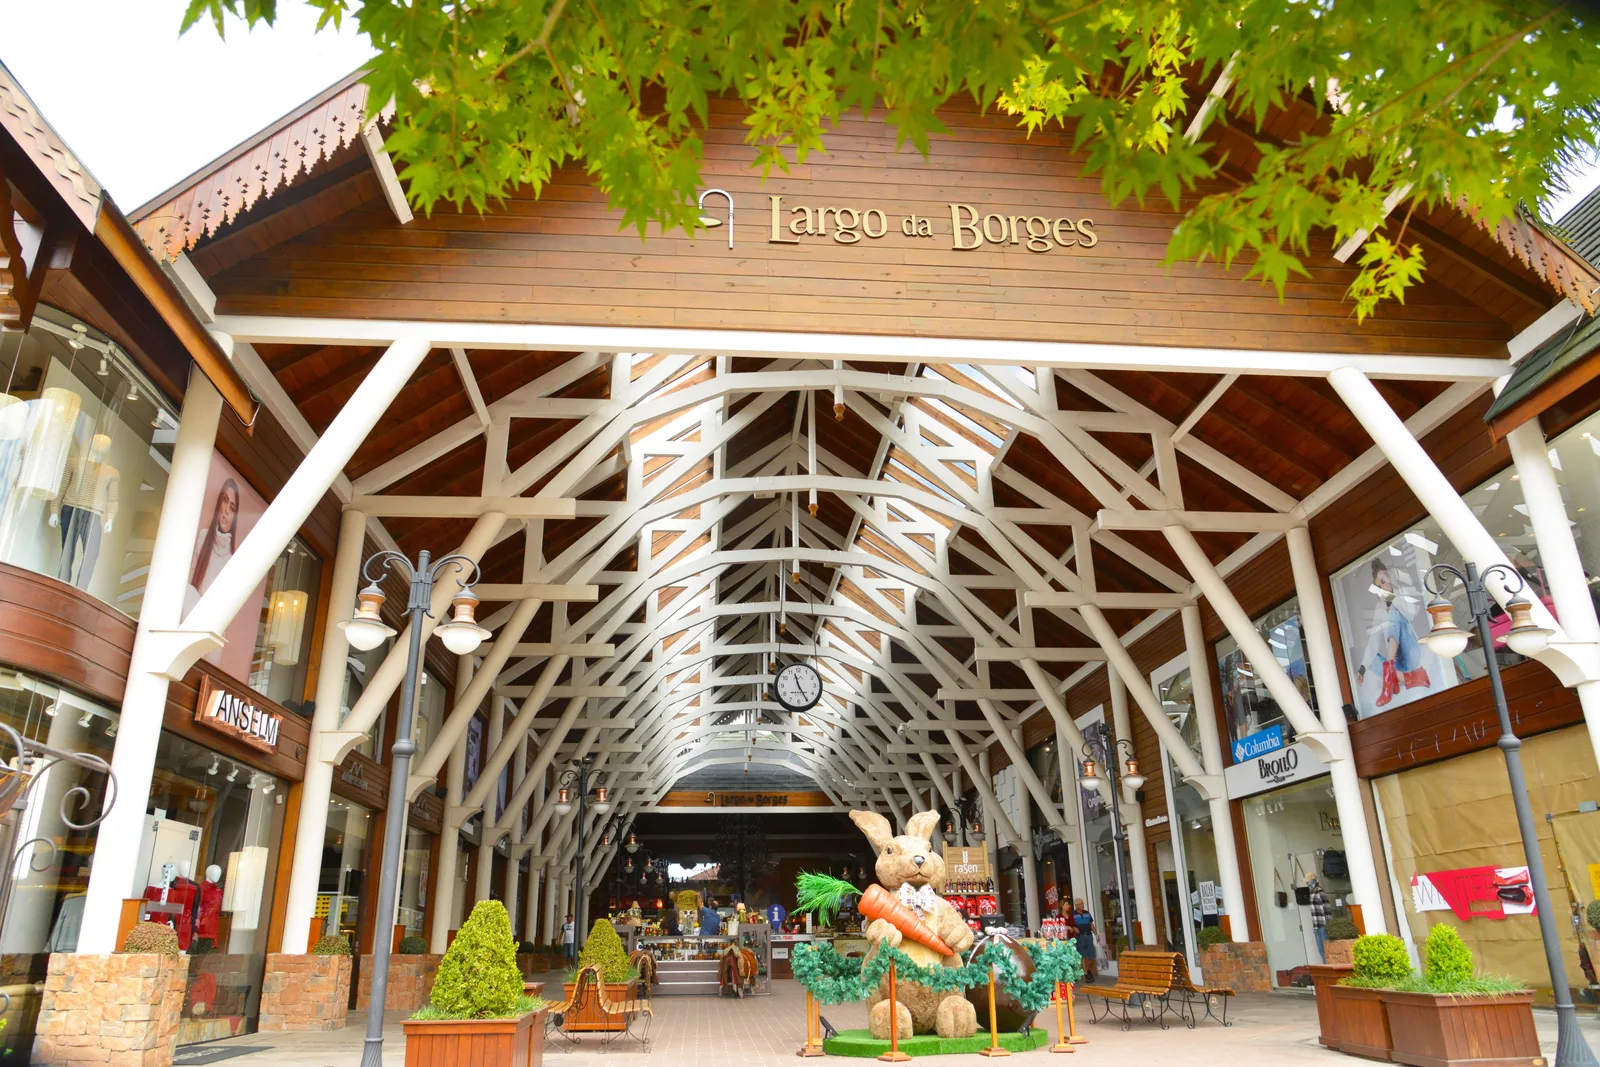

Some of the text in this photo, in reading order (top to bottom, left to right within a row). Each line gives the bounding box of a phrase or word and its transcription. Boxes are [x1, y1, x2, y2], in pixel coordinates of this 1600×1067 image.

[768, 195, 1099, 252] Largo da Borges
[211, 689, 280, 747] ANSELMI
[1244, 732, 1280, 757] Columbia
[756, 794, 788, 807] Borges
